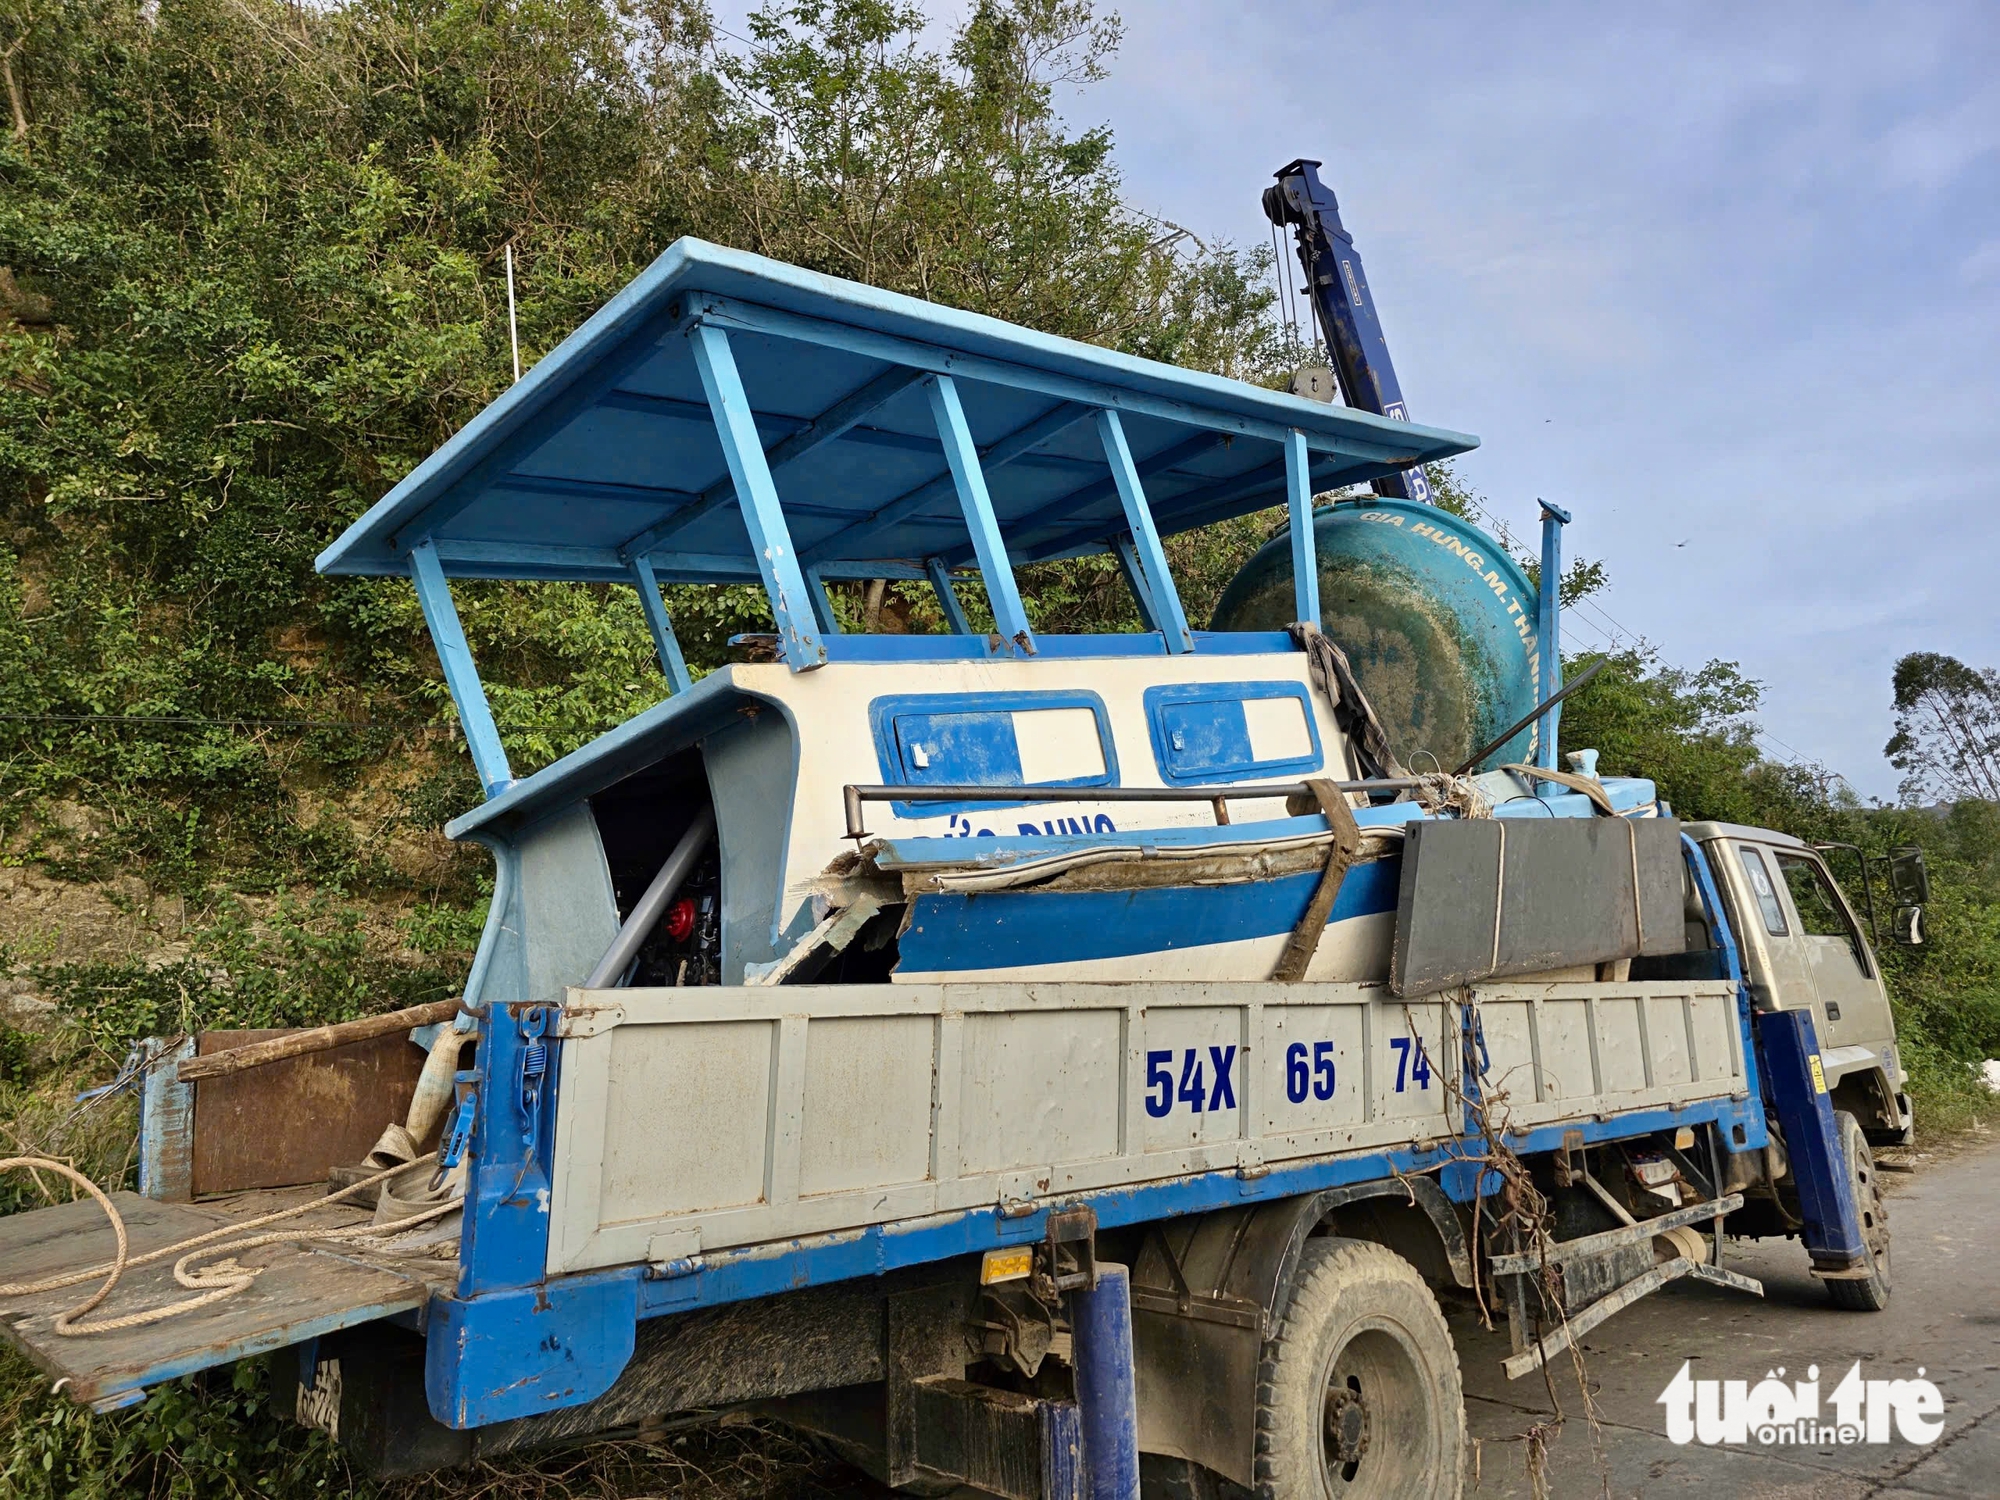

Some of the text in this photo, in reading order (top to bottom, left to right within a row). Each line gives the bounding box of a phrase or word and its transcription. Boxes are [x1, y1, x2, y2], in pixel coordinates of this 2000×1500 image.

[1359, 511, 1406, 527] GIA
[1145, 1036, 1431, 1118] 54X 65 74
